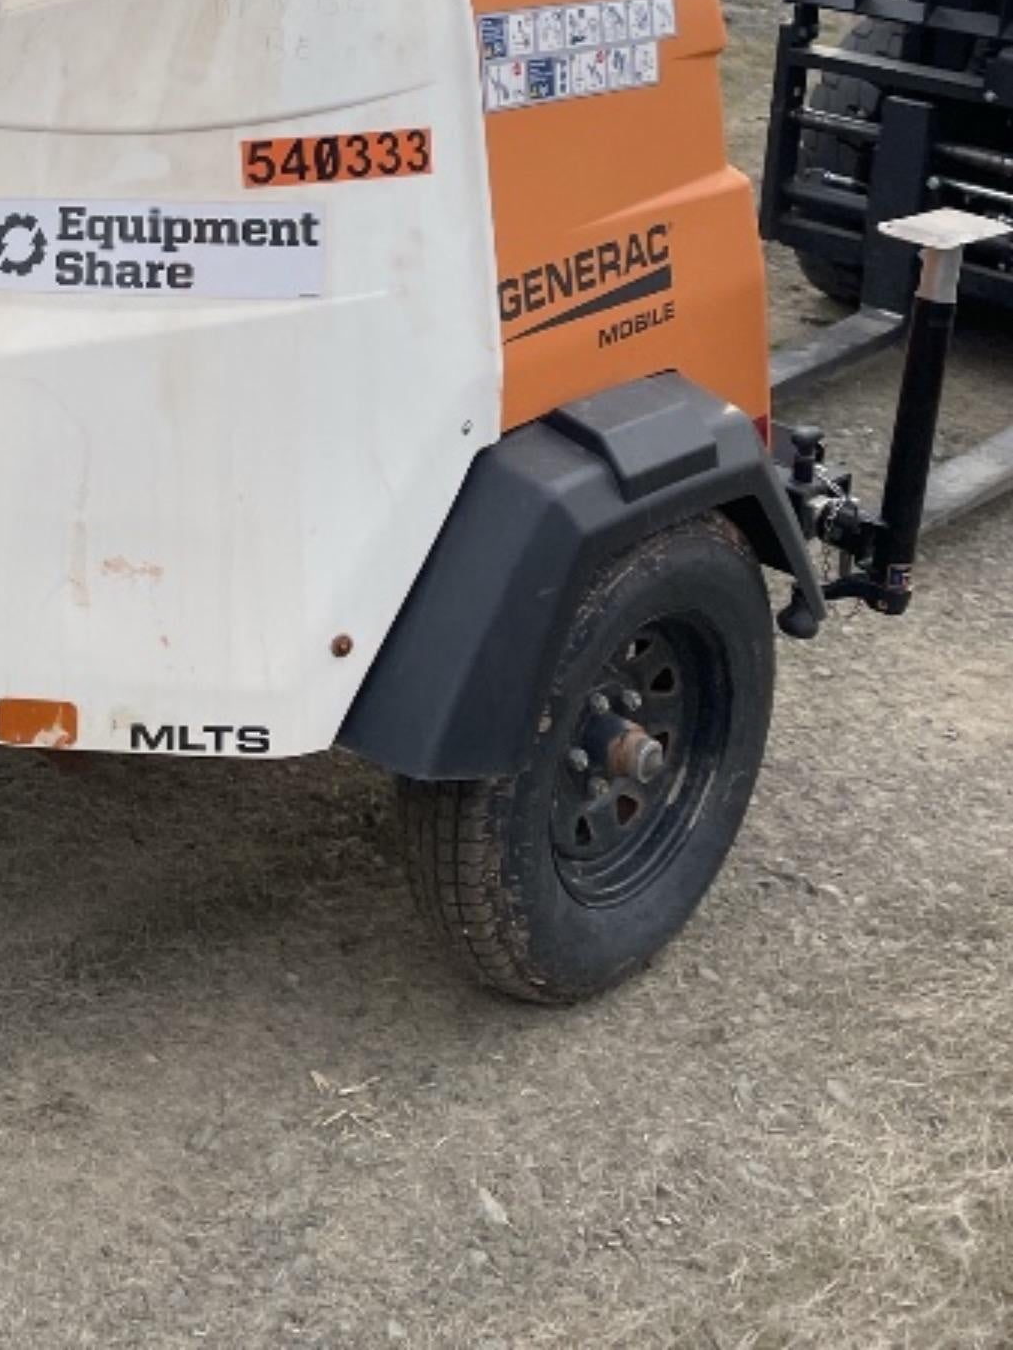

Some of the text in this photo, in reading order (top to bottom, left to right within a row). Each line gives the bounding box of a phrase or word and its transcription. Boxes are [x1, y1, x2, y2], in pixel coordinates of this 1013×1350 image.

[246, 128, 430, 185] 540333
[56, 206, 320, 252] Equipment
[54, 250, 194, 290] Share
[497, 223, 670, 322] GENERAC
[598, 300, 675, 348] MOBILE
[129, 722, 271, 754] MLTS
